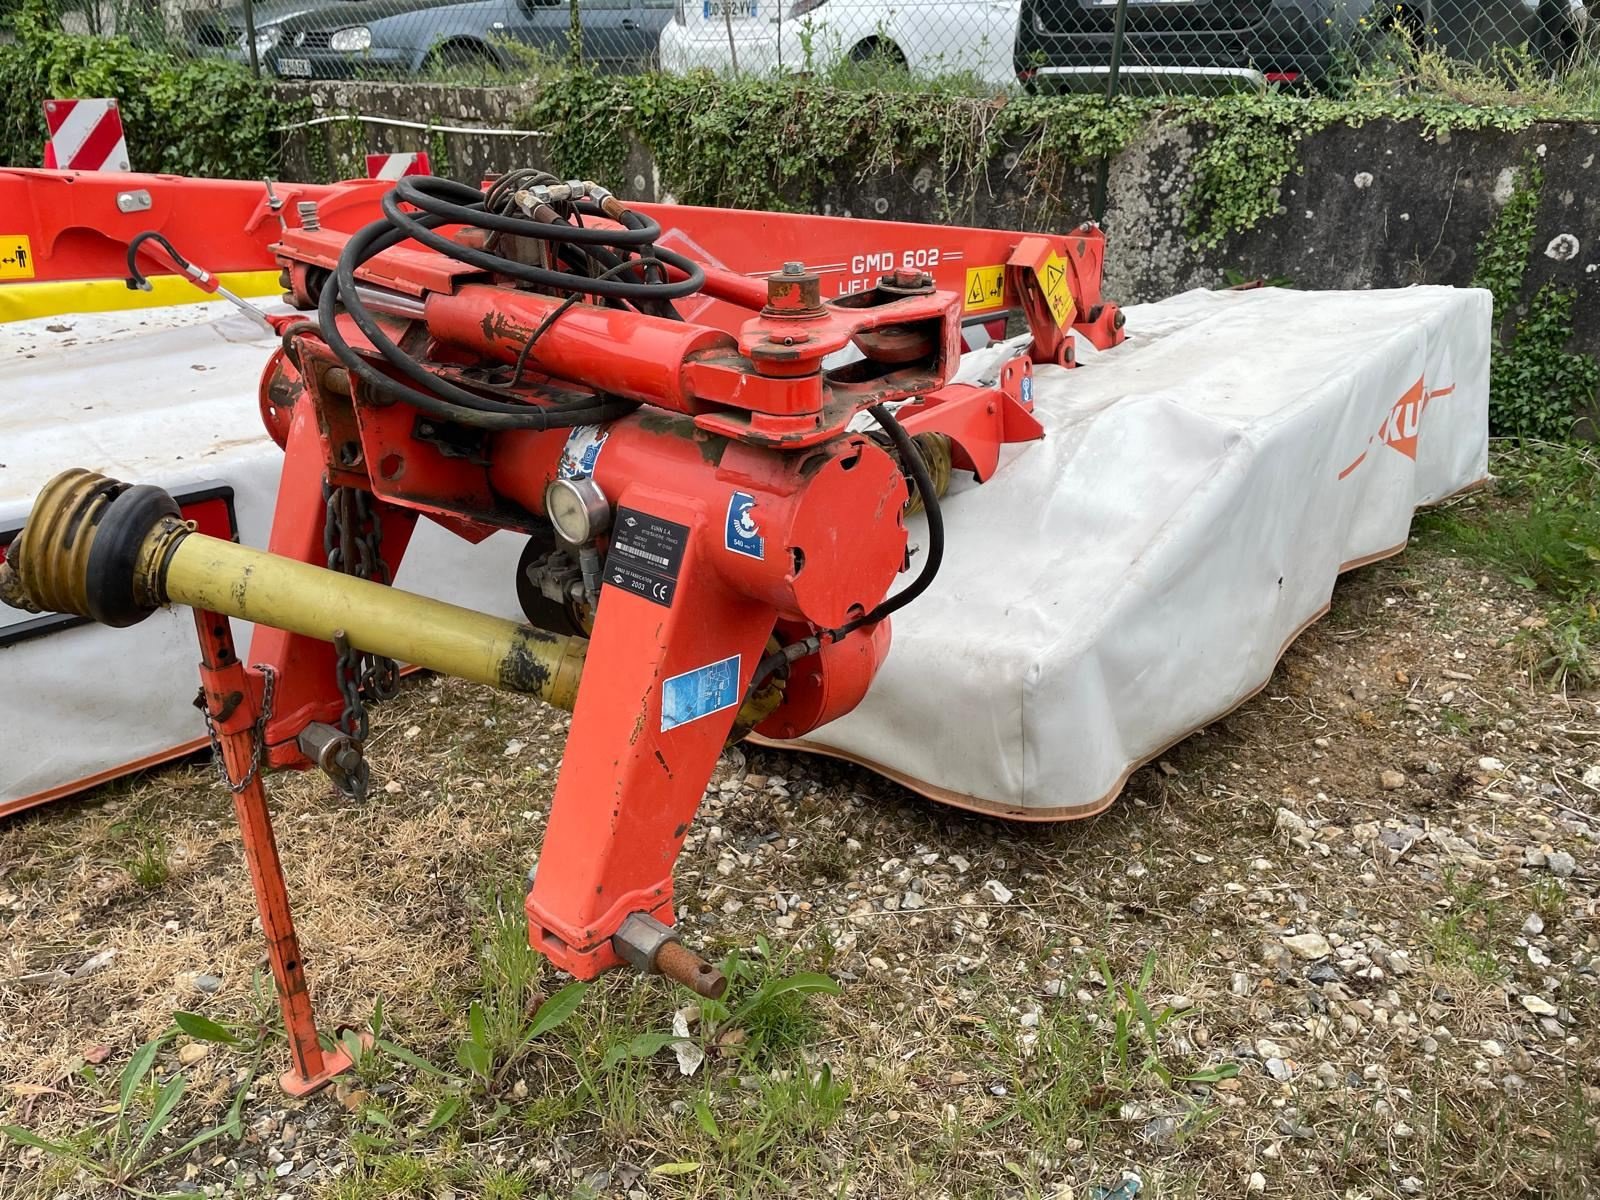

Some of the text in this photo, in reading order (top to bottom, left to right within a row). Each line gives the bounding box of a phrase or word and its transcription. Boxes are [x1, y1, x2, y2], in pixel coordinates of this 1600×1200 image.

[852, 248, 939, 274] GMD 602
[839, 278, 870, 295] LIFT
[631, 580, 668, 600] 2003 CE
